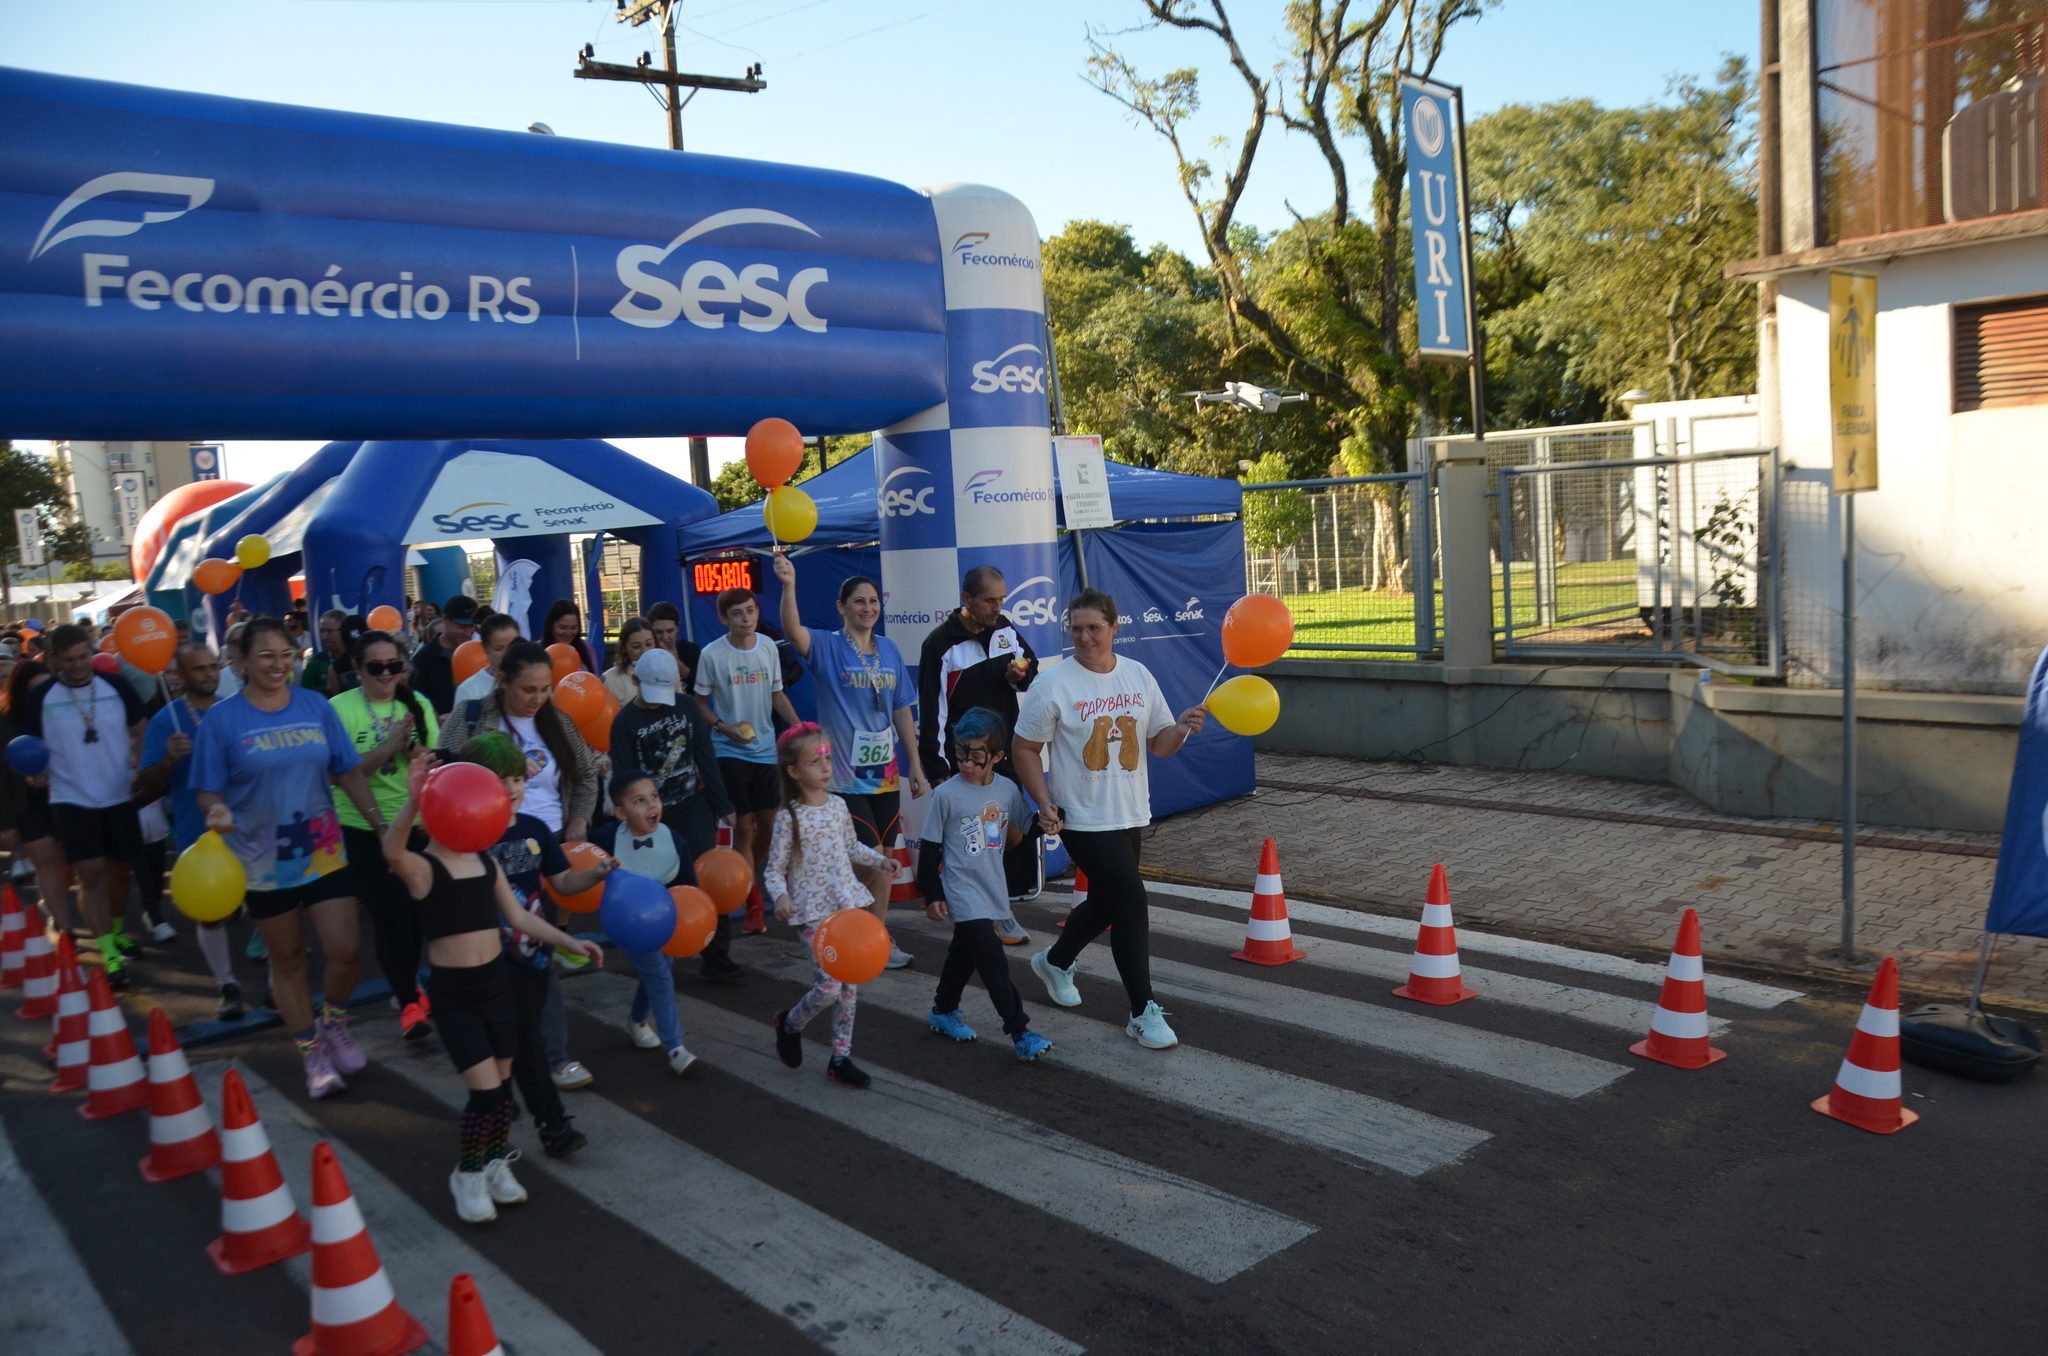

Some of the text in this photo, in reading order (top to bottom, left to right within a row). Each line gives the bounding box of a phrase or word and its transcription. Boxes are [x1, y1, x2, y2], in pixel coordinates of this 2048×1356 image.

[610, 208, 830, 334] Sesc
[961, 252, 1034, 270] Fecomércio
[1418, 168, 1453, 344] URI
[83, 253, 542, 325] Fecomércio RS
[970, 344, 1045, 395] Sesc
[973, 488, 1047, 504] Fecomércio
[433, 501, 615, 534] Sesc Fecomércio
[884, 611, 931, 625] comércio
[1001, 580, 1058, 627] esc
[1080, 692, 1145, 722] CAPYBARAS
[858, 742, 891, 764] 362
